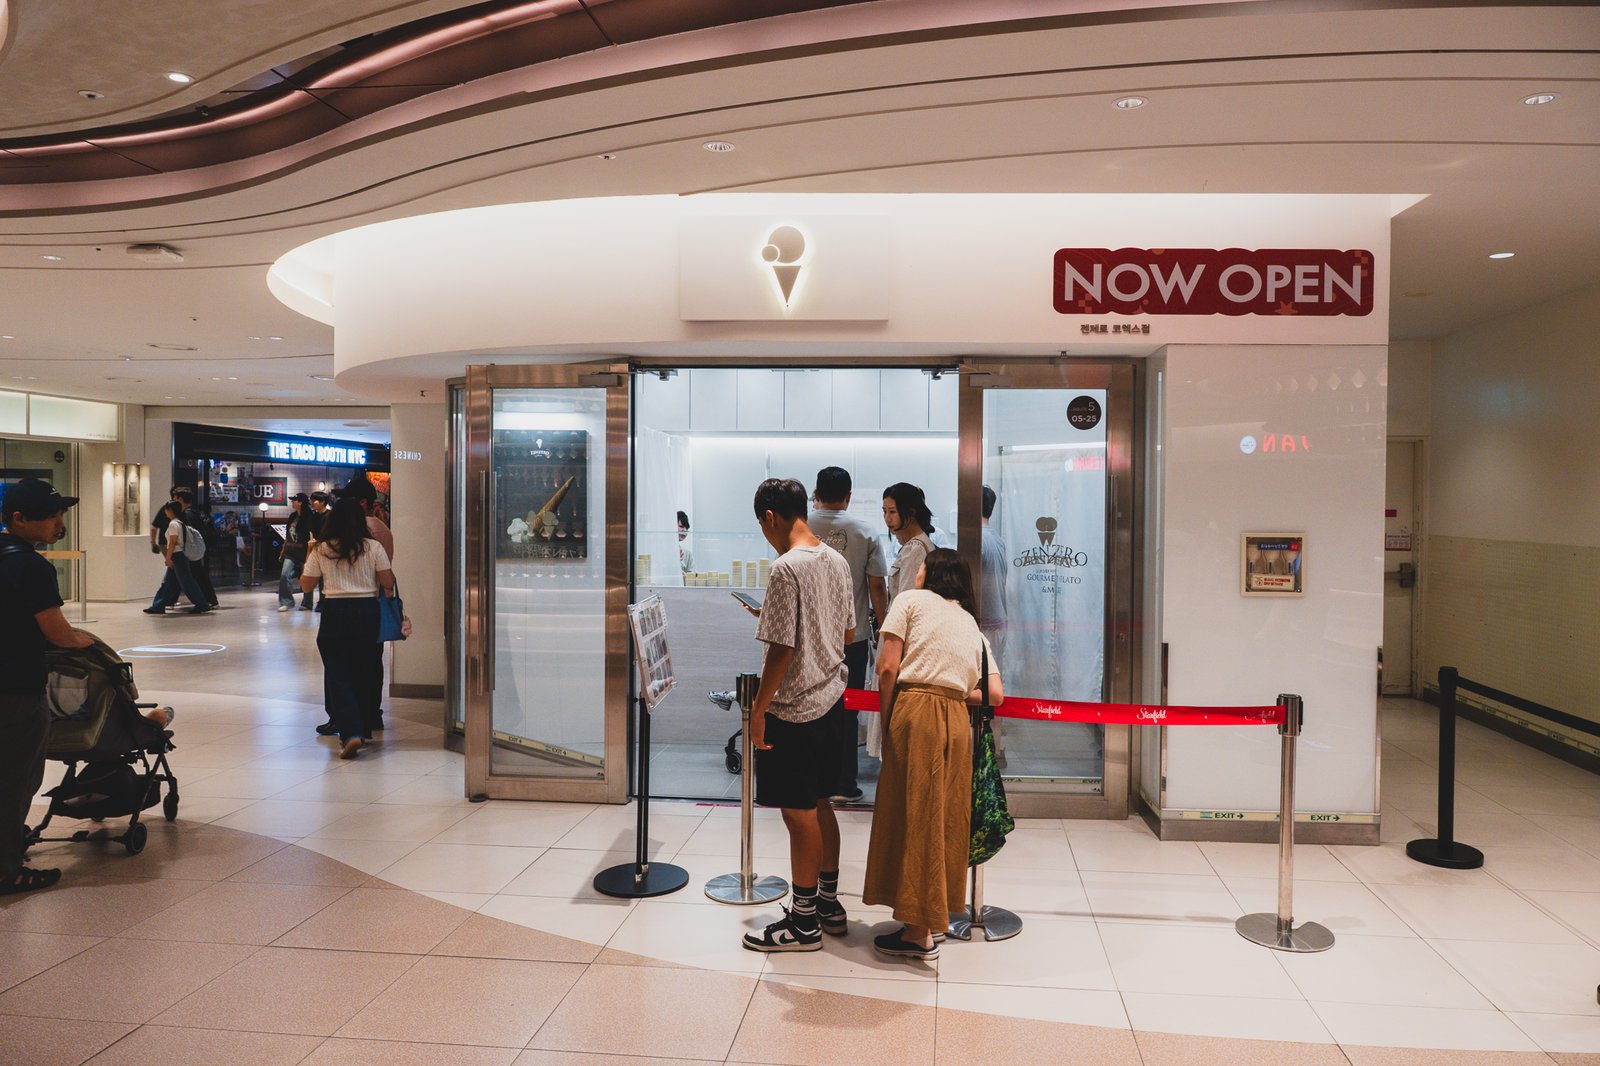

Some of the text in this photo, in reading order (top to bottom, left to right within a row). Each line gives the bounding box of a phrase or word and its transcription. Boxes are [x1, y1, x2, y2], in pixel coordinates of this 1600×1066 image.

[1064, 260, 1361, 306] NOW OPEN
[1088, 401, 1096, 412] 5
[1071, 415, 1097, 423] 05-25
[267, 441, 366, 465] THE TACO BOOTH NYC
[1032, 702, 1062, 719] Starfield
[1136, 707, 1167, 723] Starfield
